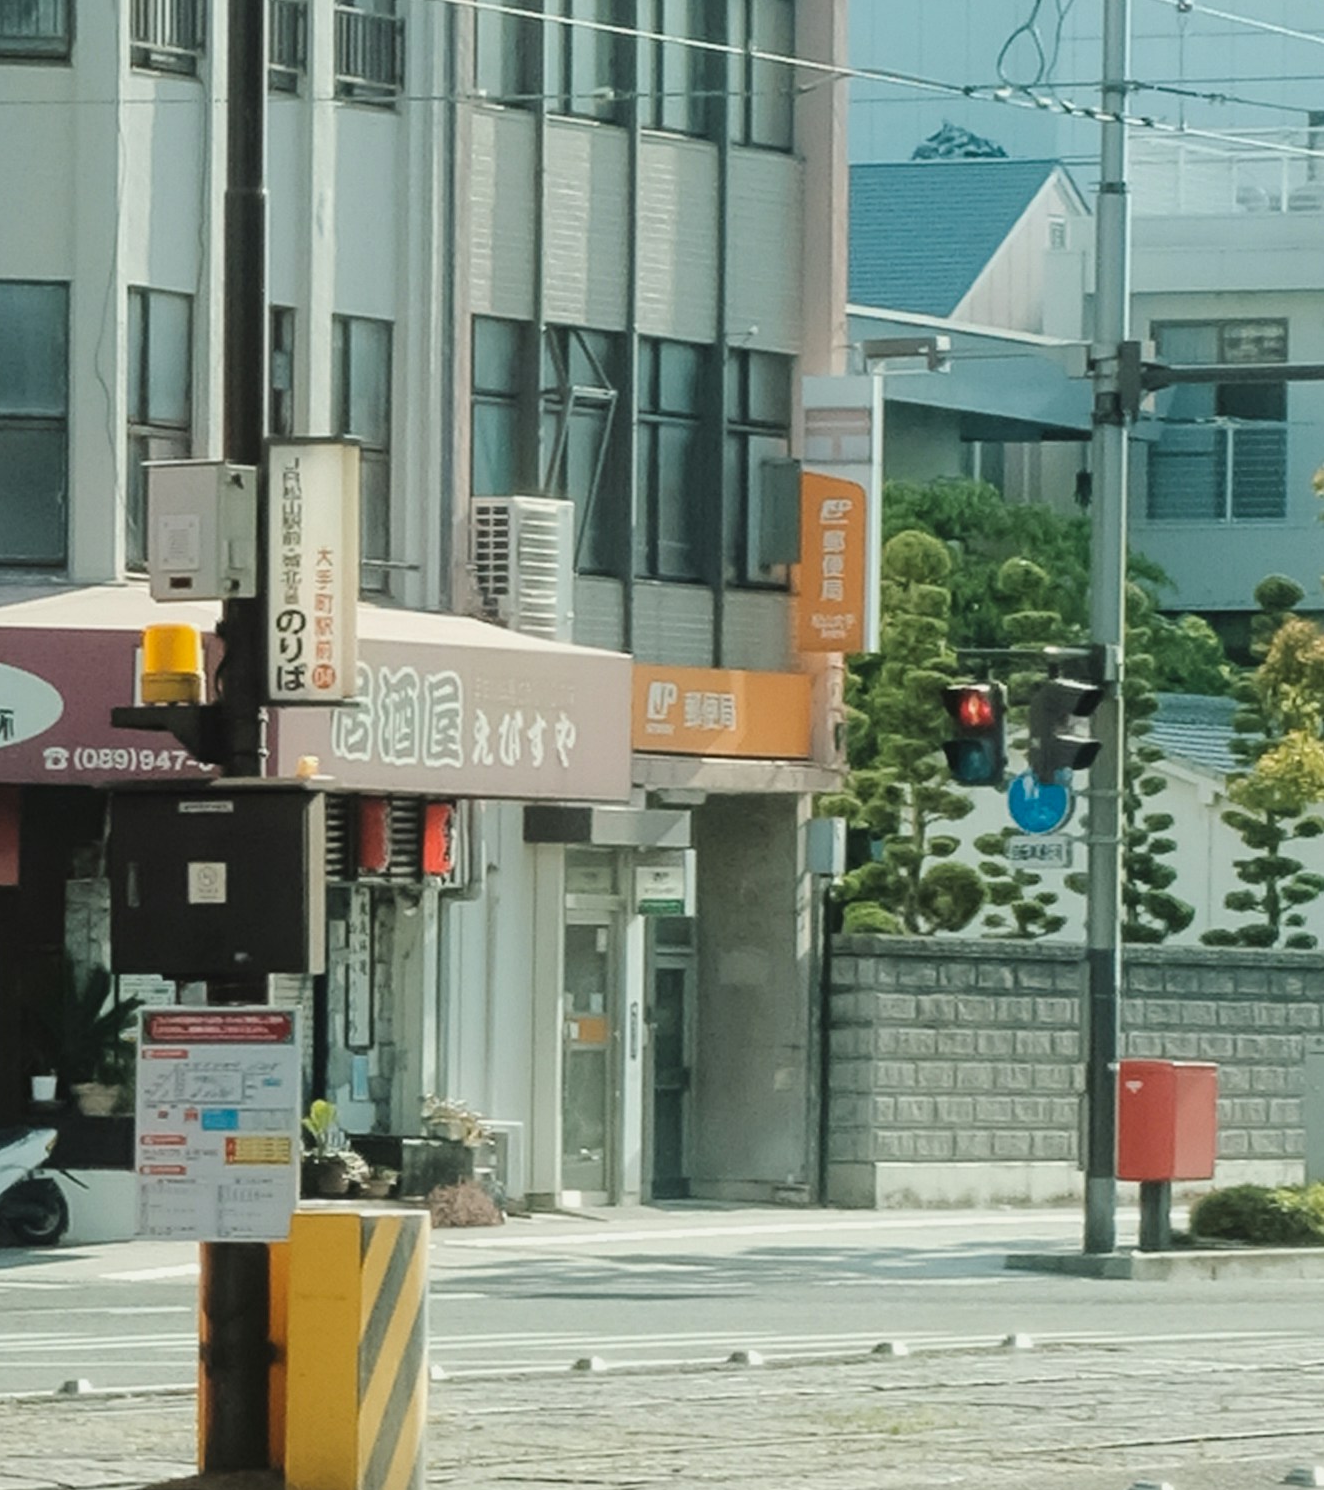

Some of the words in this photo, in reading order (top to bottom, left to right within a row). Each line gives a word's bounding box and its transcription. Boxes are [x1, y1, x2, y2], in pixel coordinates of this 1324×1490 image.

[276, 609, 306, 691] のりば
[332, 662, 464, 767] 居酒屋
[472, 710, 577, 768] えびすや
[684, 690, 736, 732] 郵便局
